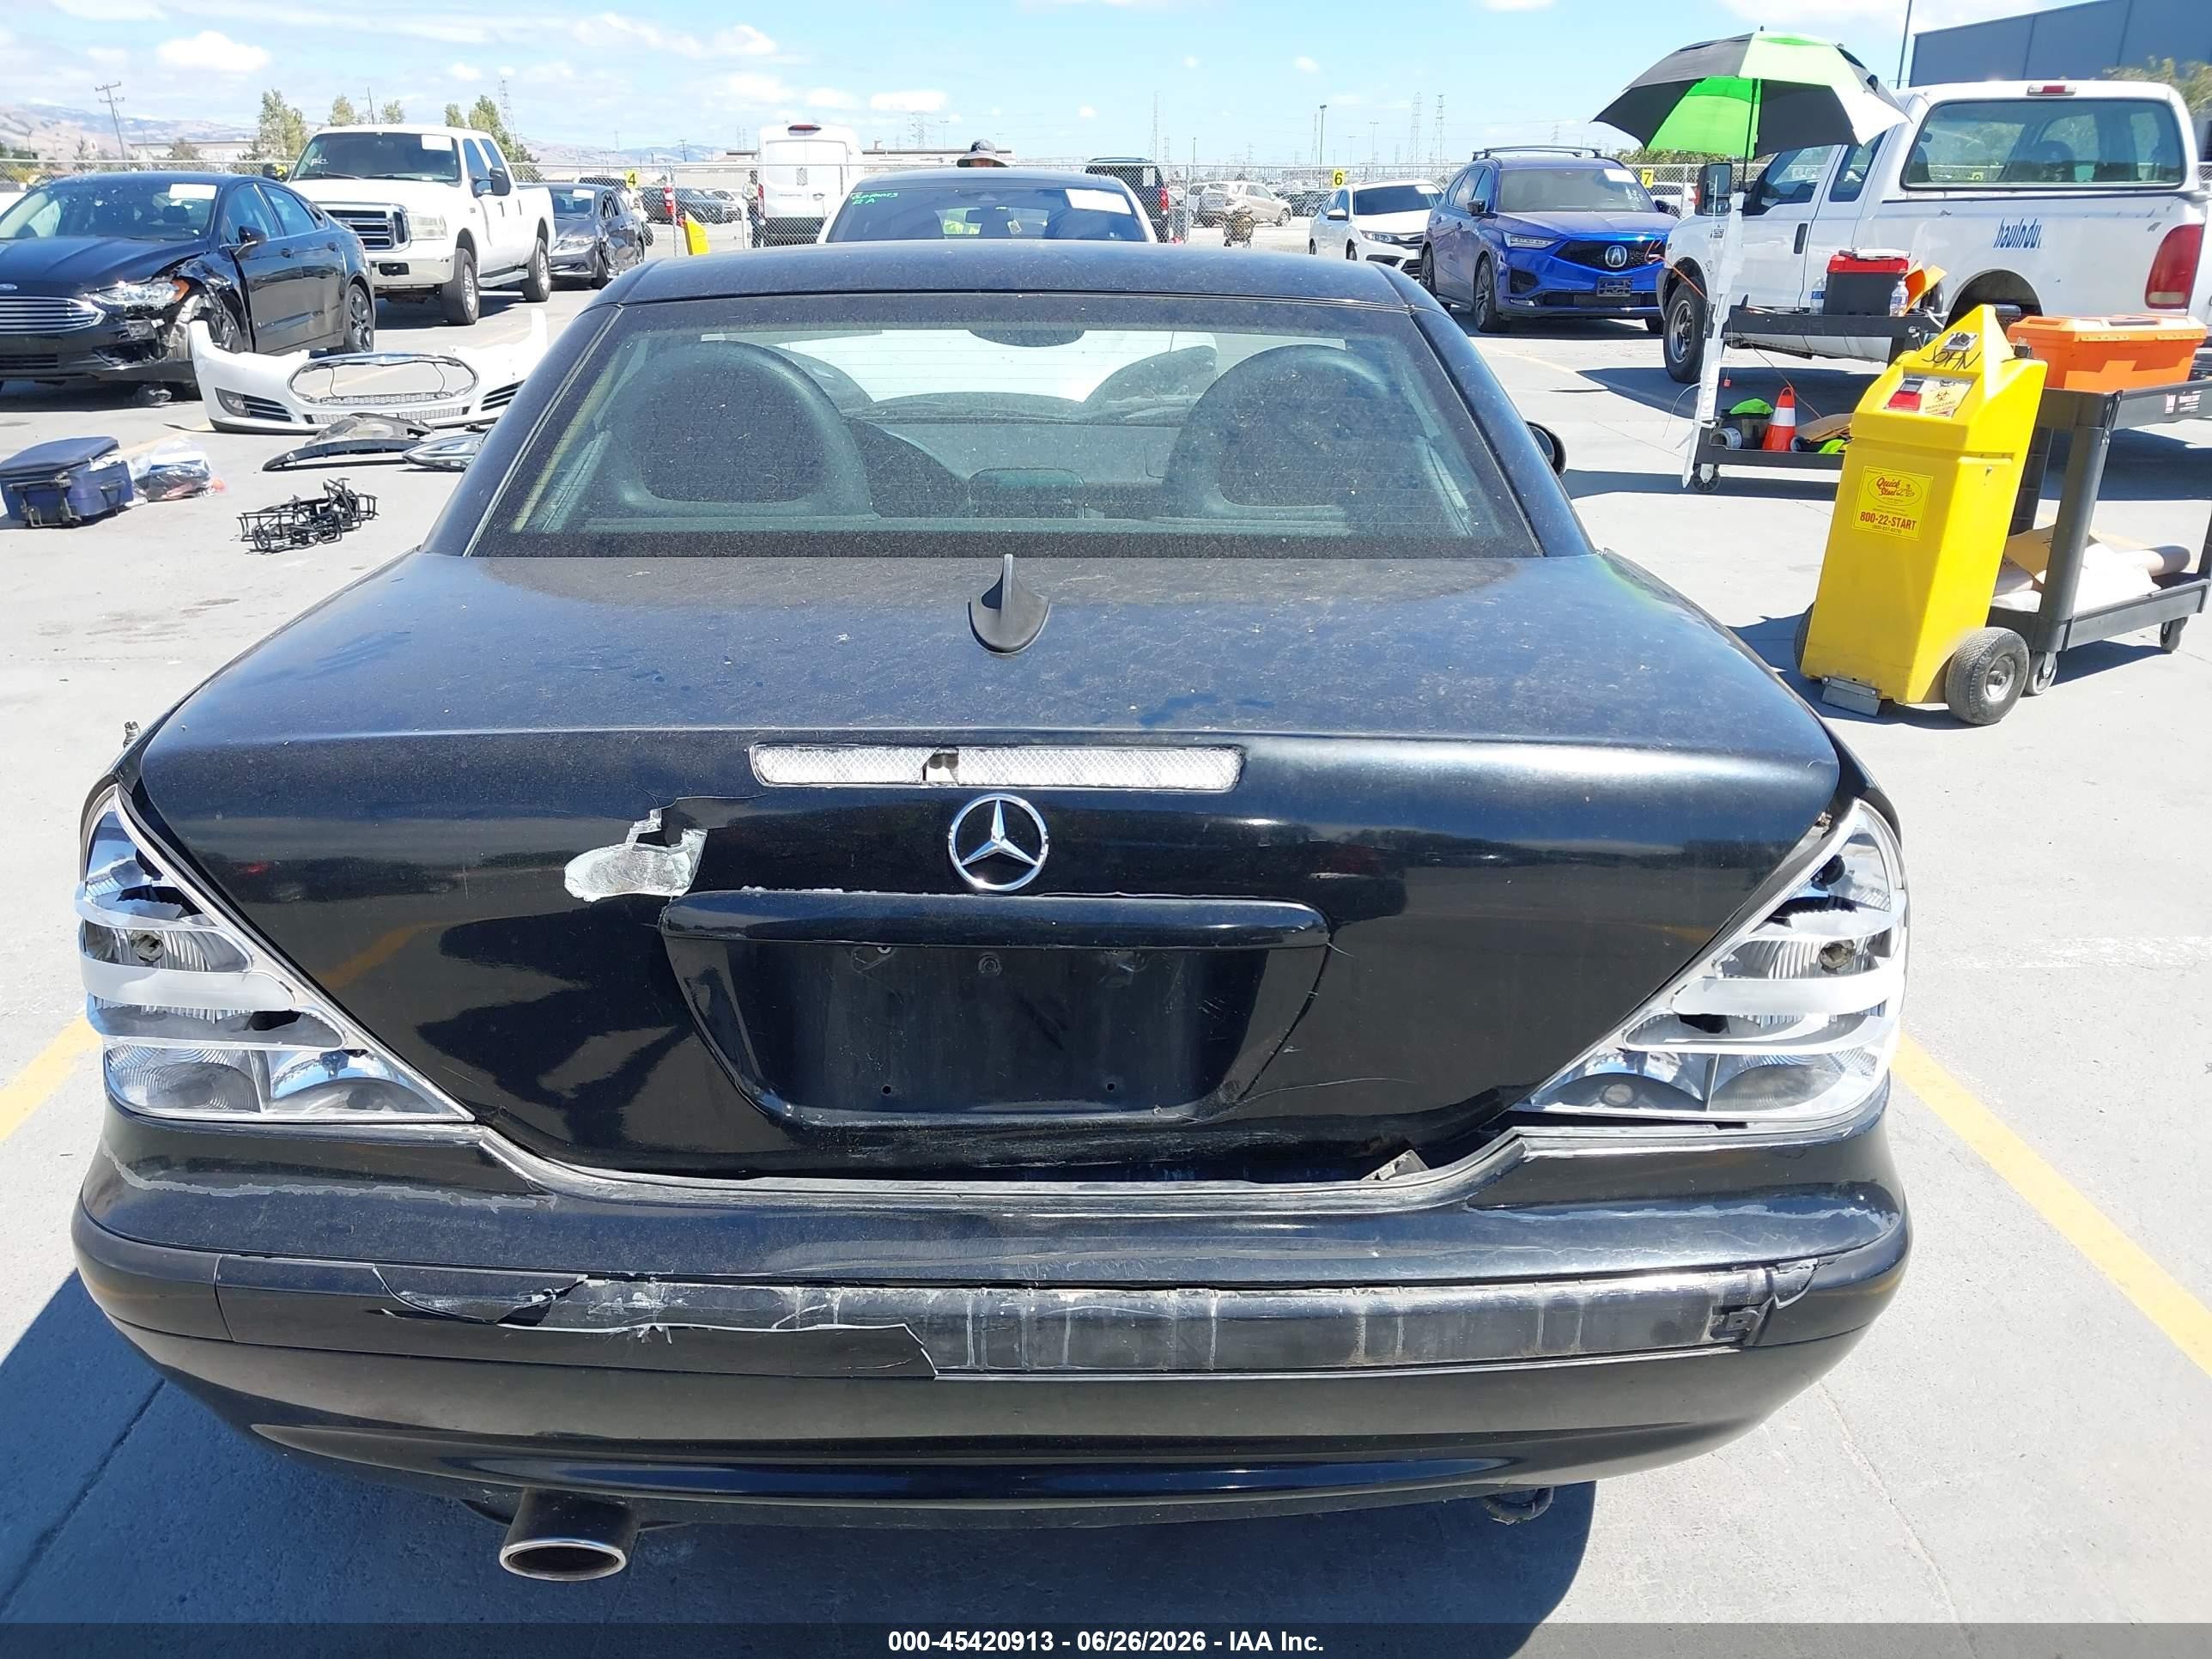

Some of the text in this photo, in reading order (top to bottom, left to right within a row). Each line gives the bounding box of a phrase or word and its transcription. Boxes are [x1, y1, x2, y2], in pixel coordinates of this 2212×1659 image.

[627, 173, 637, 185] 4
[1334, 172, 1343, 185] 6
[1644, 172, 1652, 185] 7
[1921, 345, 1982, 371] JOHN
[1875, 477, 1901, 490] Quick
[1860, 511, 1917, 531] 800-22-START
